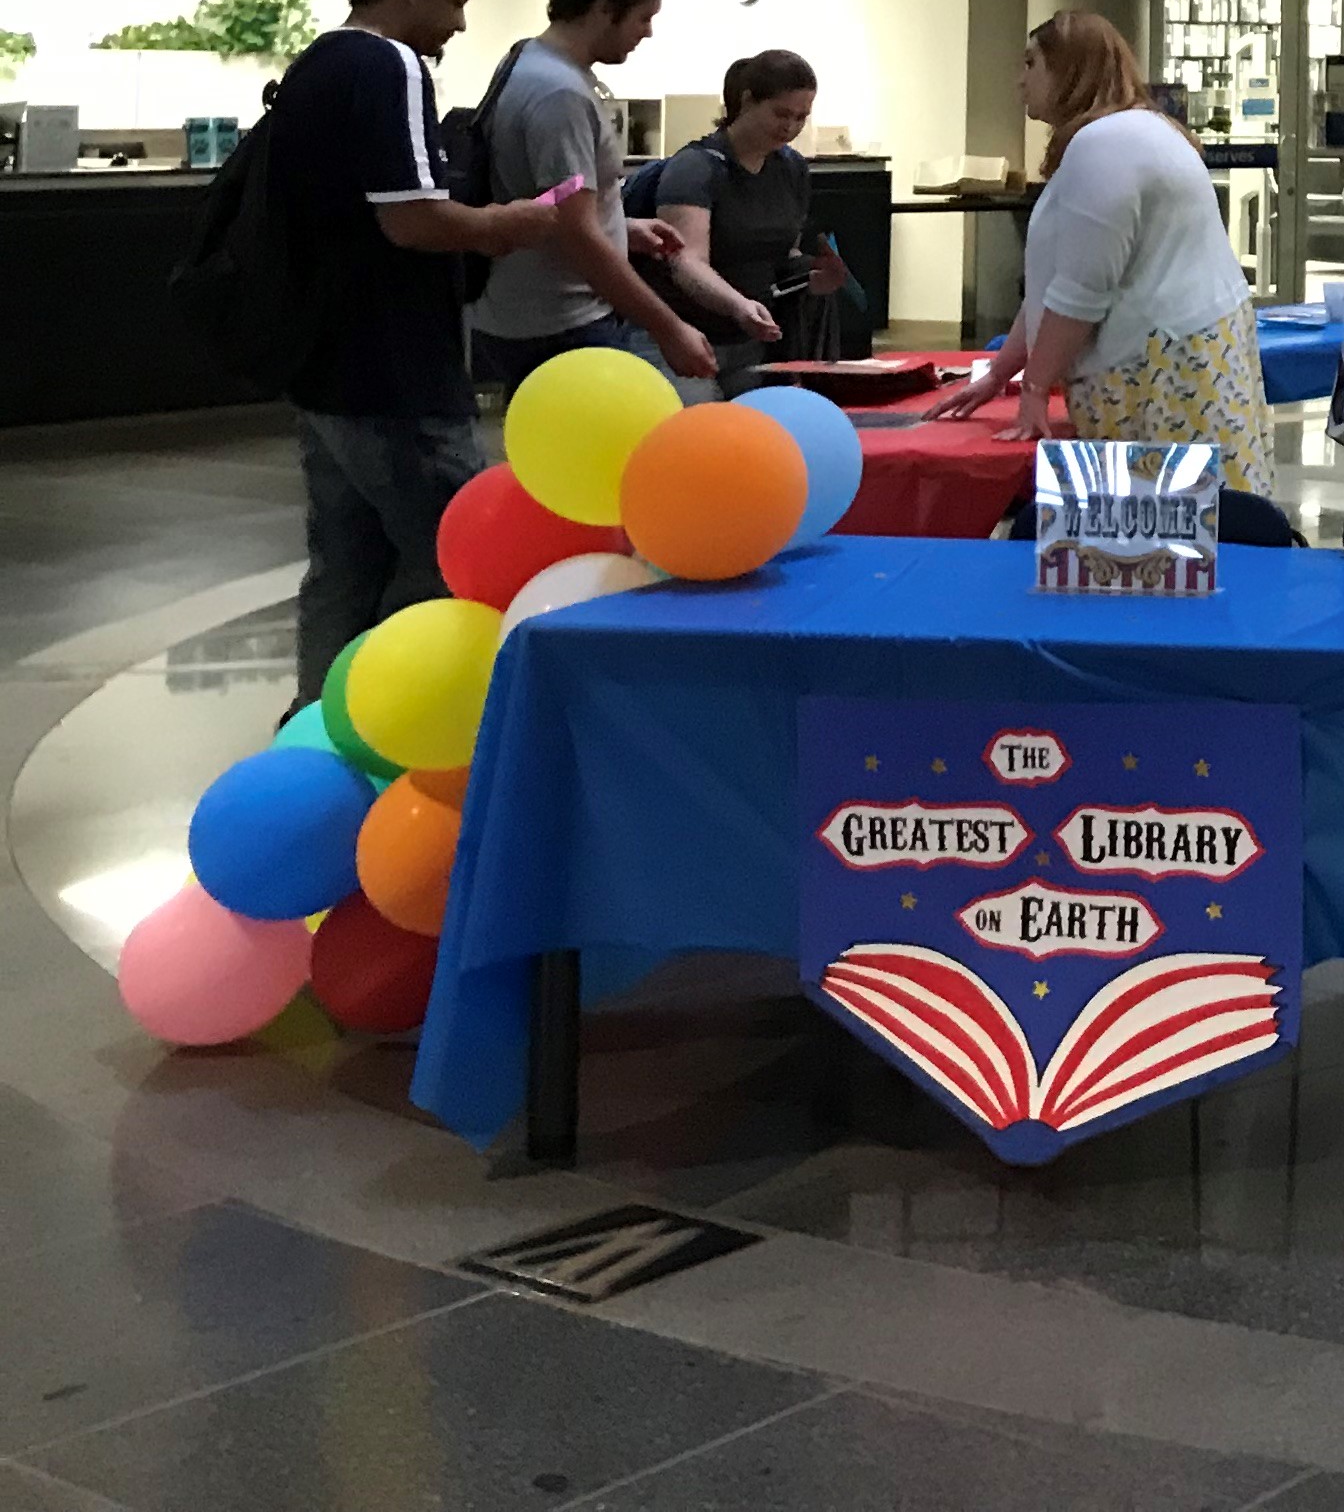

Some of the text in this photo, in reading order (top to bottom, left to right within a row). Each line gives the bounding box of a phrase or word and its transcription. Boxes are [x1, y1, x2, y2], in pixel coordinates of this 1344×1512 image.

[1063, 492, 1198, 541] WELCOME
[841, 813, 1244, 867] GREATEST LIBRARY
[1019, 896, 1140, 944] EARTH
